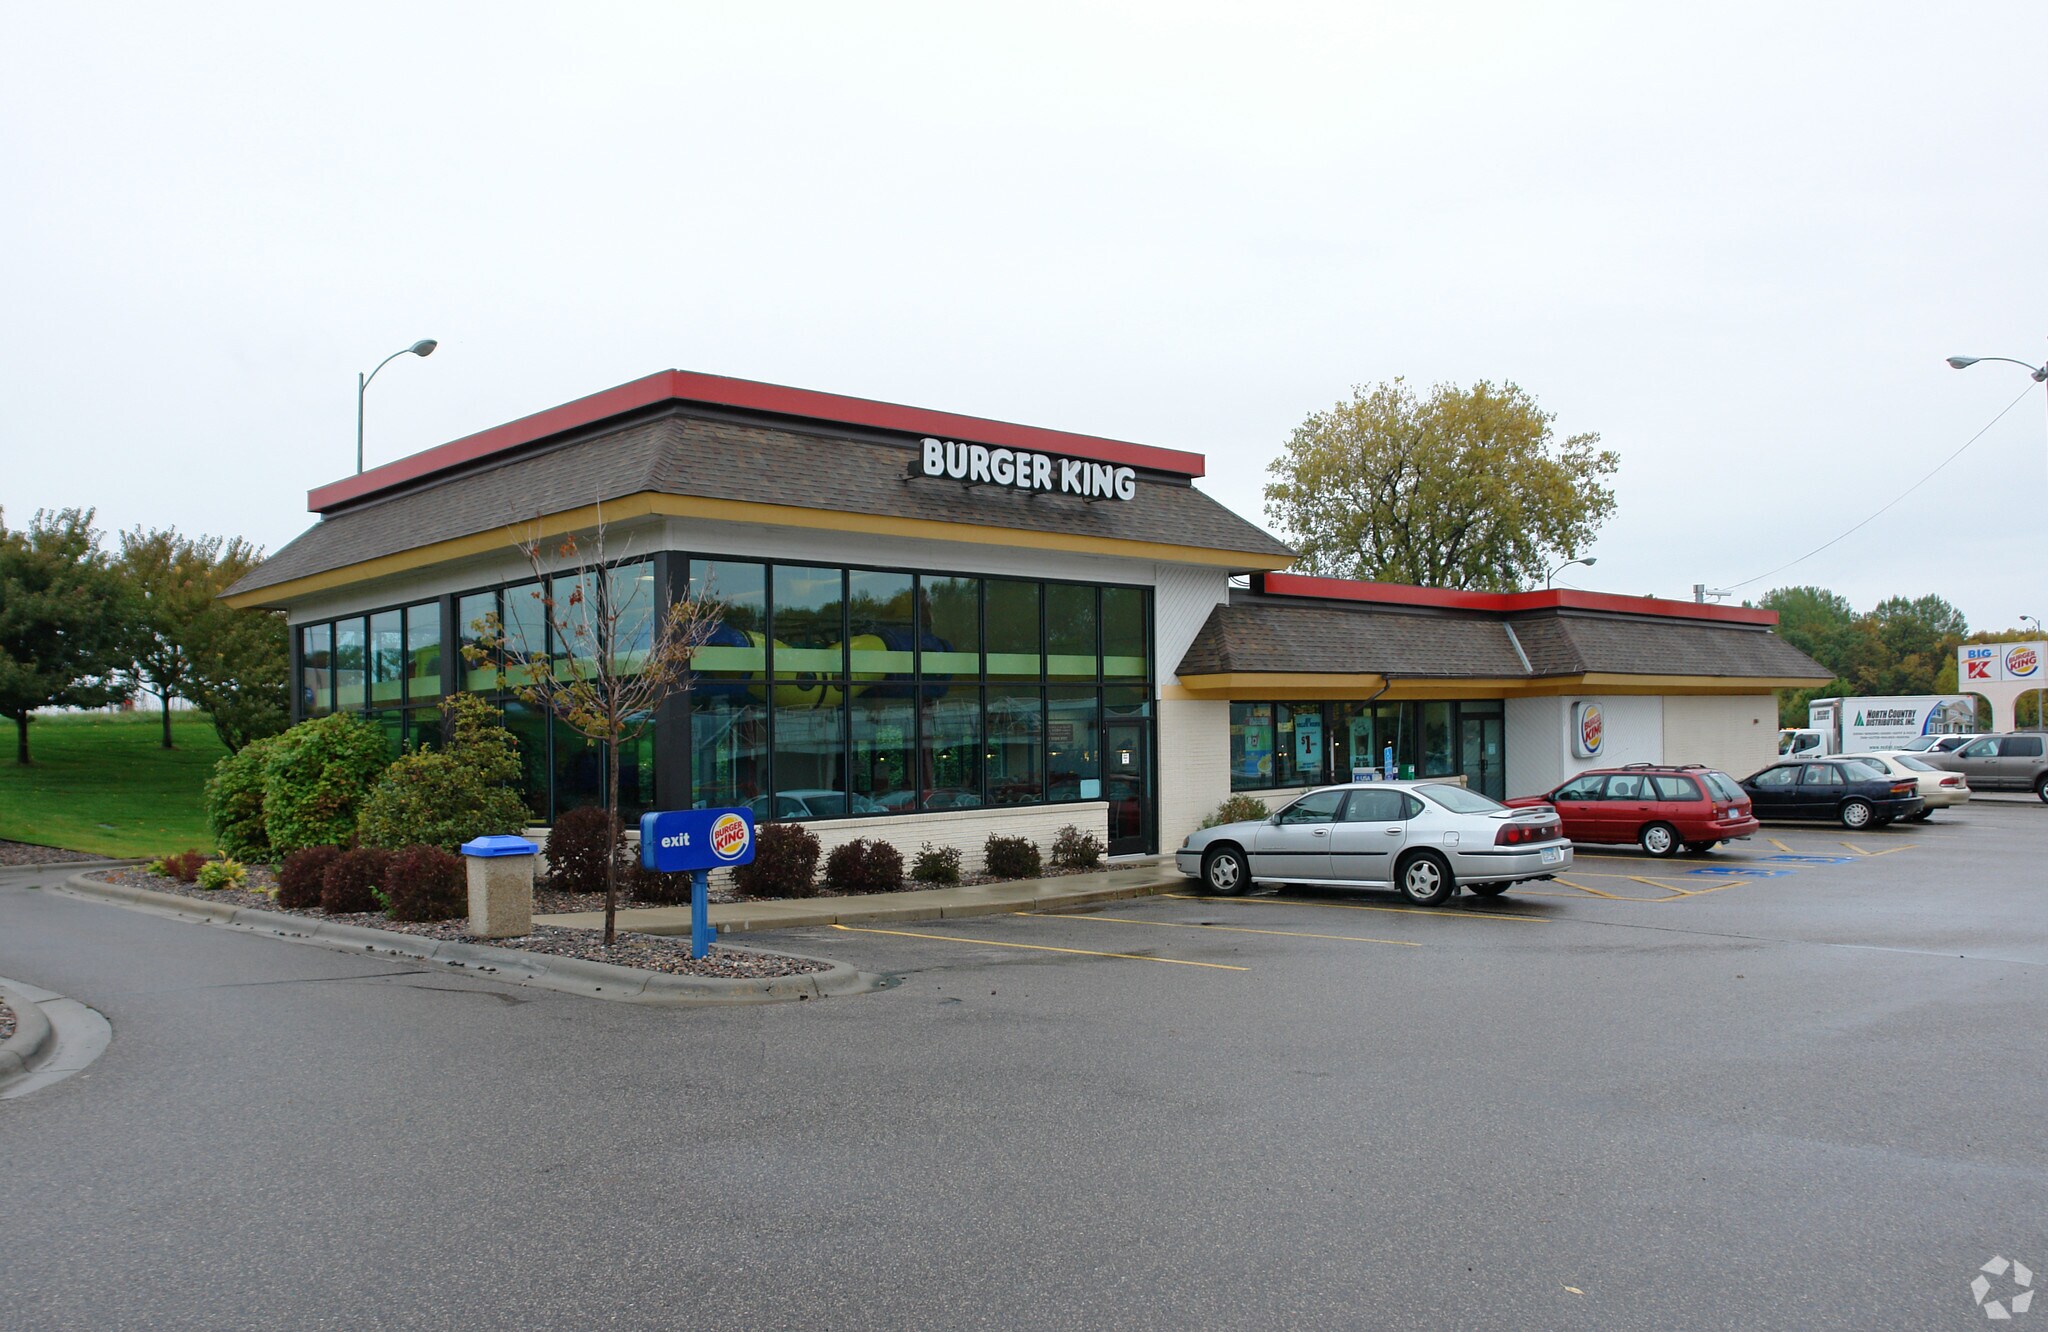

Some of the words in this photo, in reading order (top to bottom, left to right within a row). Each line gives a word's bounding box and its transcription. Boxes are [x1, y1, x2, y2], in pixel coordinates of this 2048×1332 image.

[921, 437, 1052, 491] BURGER
[1057, 458, 1136, 501] KING
[1968, 649, 1992, 659] BIG
[2008, 651, 2036, 664] BURGER
[2010, 656, 2037, 671] KING
[1866, 709, 1888, 719] NORTH
[714, 821, 743, 840] BURGER
[661, 832, 690, 848] exit
[715, 829, 744, 851] KING
